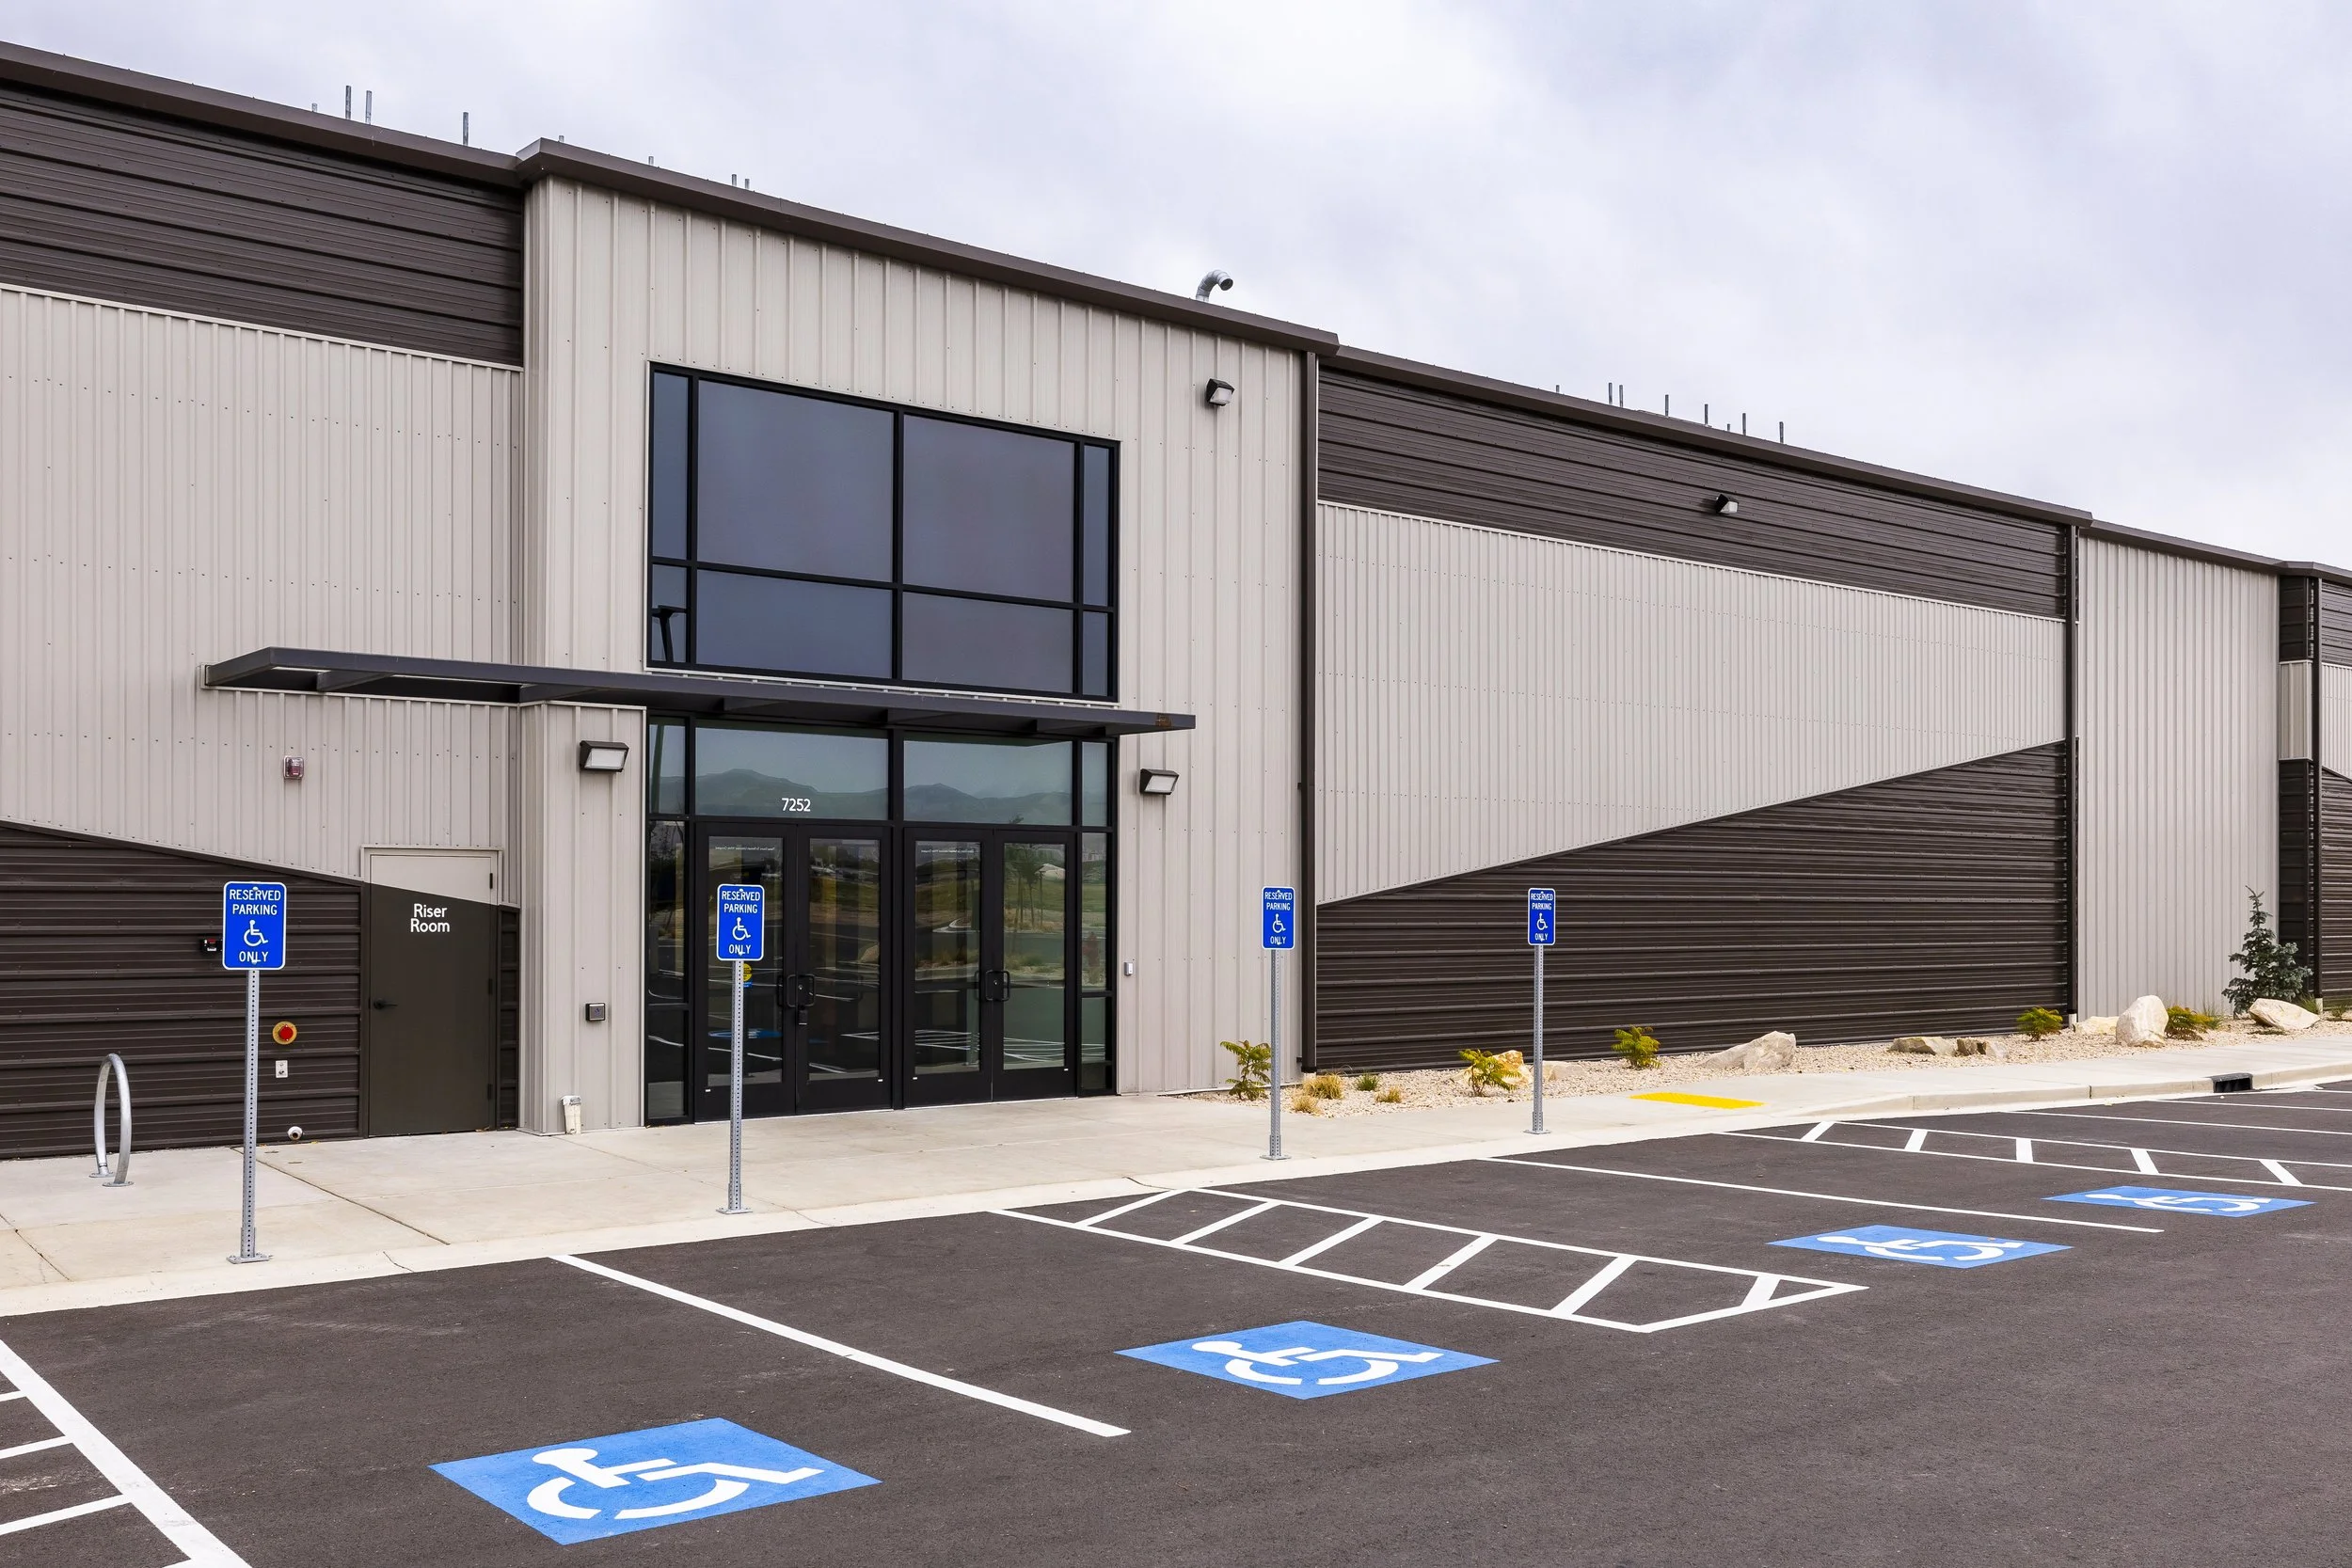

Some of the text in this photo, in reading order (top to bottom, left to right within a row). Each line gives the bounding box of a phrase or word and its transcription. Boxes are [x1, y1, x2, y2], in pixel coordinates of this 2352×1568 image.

[781, 798, 811, 812] 7252
[229, 889, 281, 901] RESERVED
[722, 891, 760, 901] RESERVED
[1264, 892, 1293, 900] RESERVED
[232, 904, 278, 915] PARKING
[414, 903, 448, 918] Riser
[723, 903, 758, 914] PARKING
[1265, 902, 1291, 911] PARKING
[1532, 902, 1552, 911] PARKING
[410, 918, 451, 933] Room
[1270, 936, 1286, 944] ONLY
[1534, 932, 1549, 941] ONLY
[728, 943, 751, 955] ONLY
[239, 951, 269, 962] ONLY
